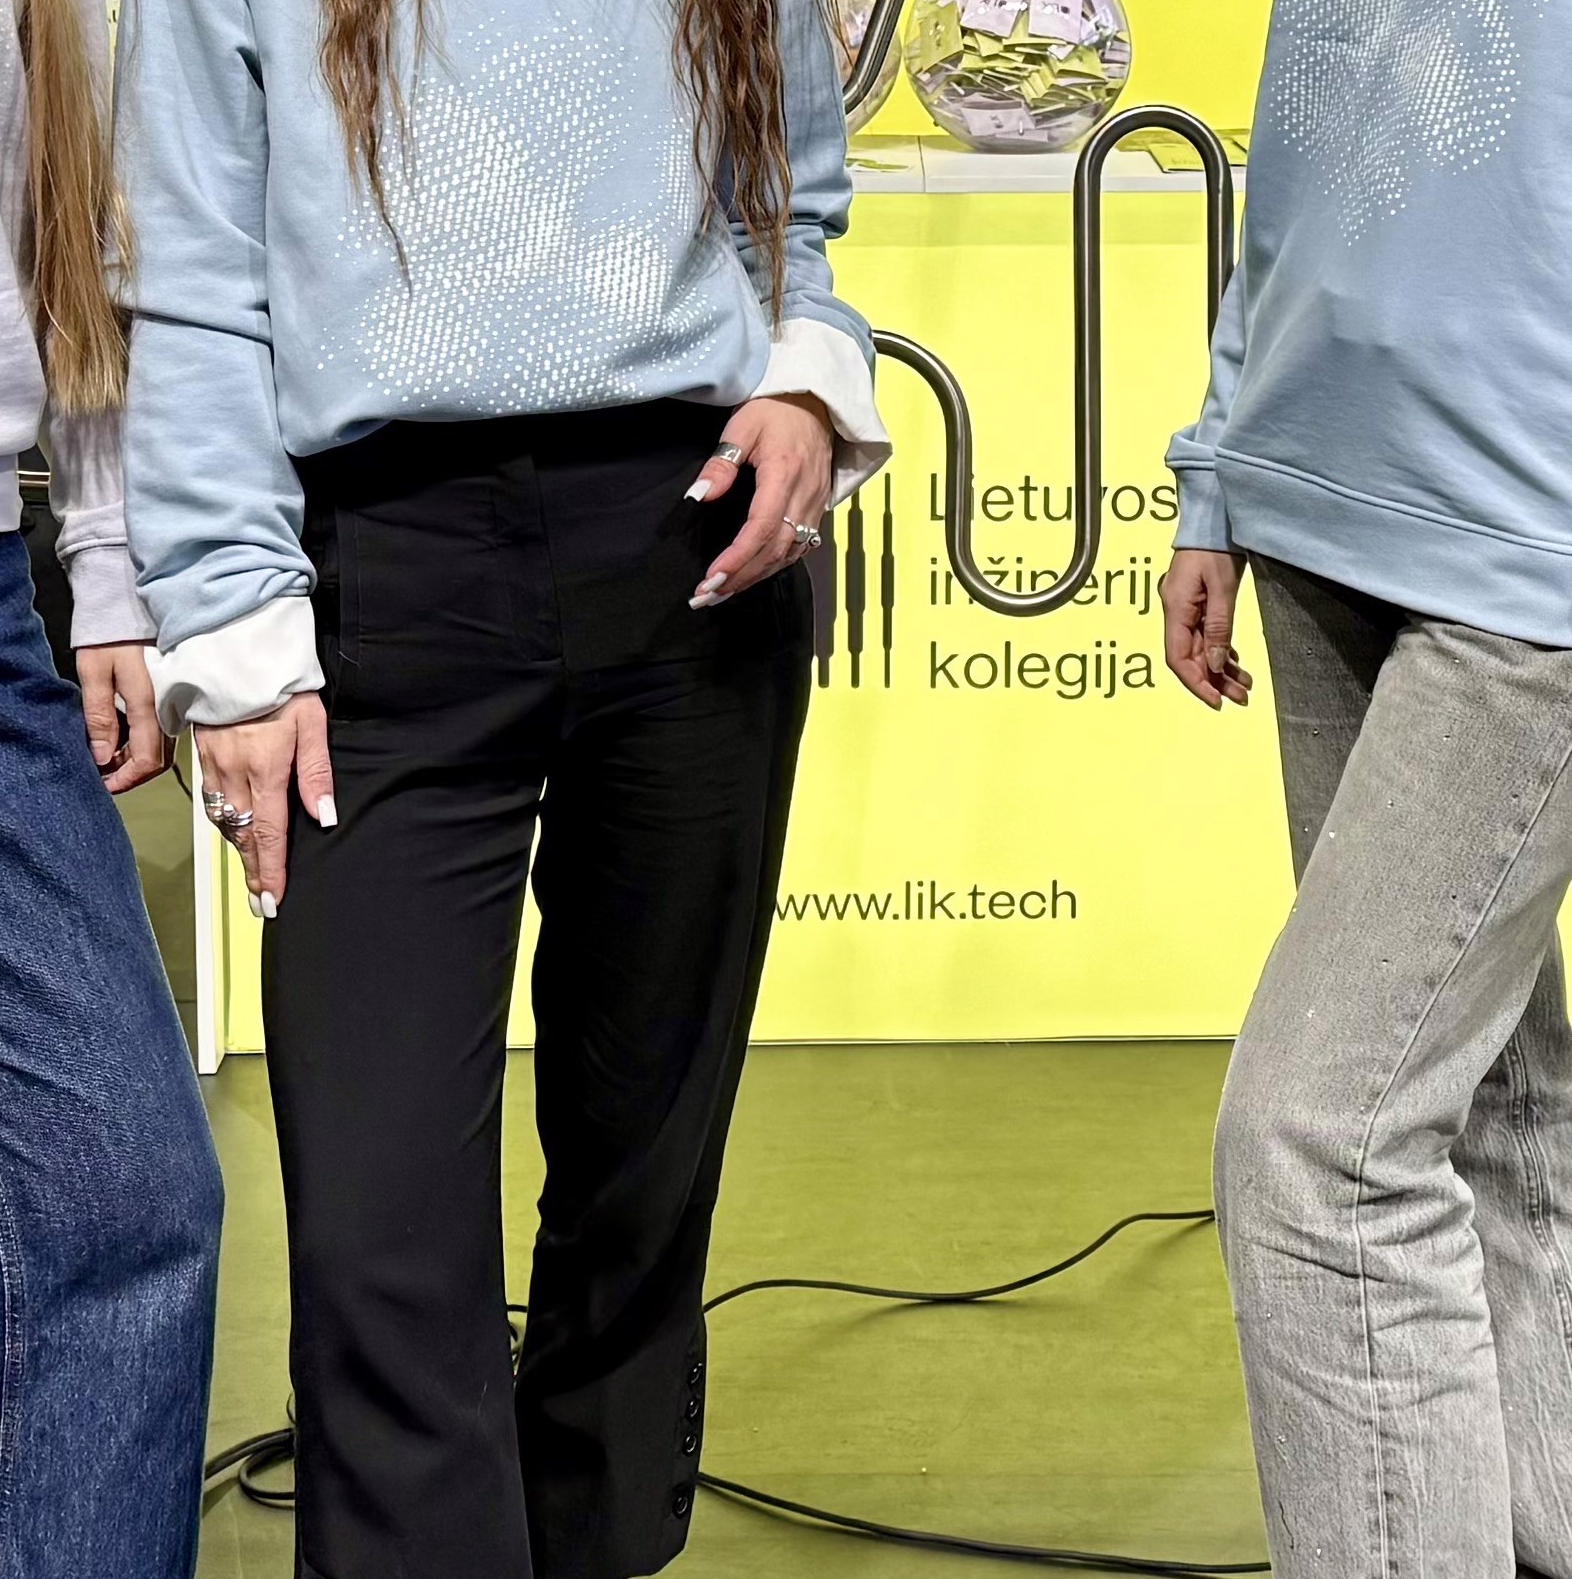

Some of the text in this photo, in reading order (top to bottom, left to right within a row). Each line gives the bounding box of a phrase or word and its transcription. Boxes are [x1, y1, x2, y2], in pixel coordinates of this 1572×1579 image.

[929, 472, 1179, 522] Letuos
[929, 640, 1156, 701] kolegija
[776, 879, 1077, 921] www.lik.tech
